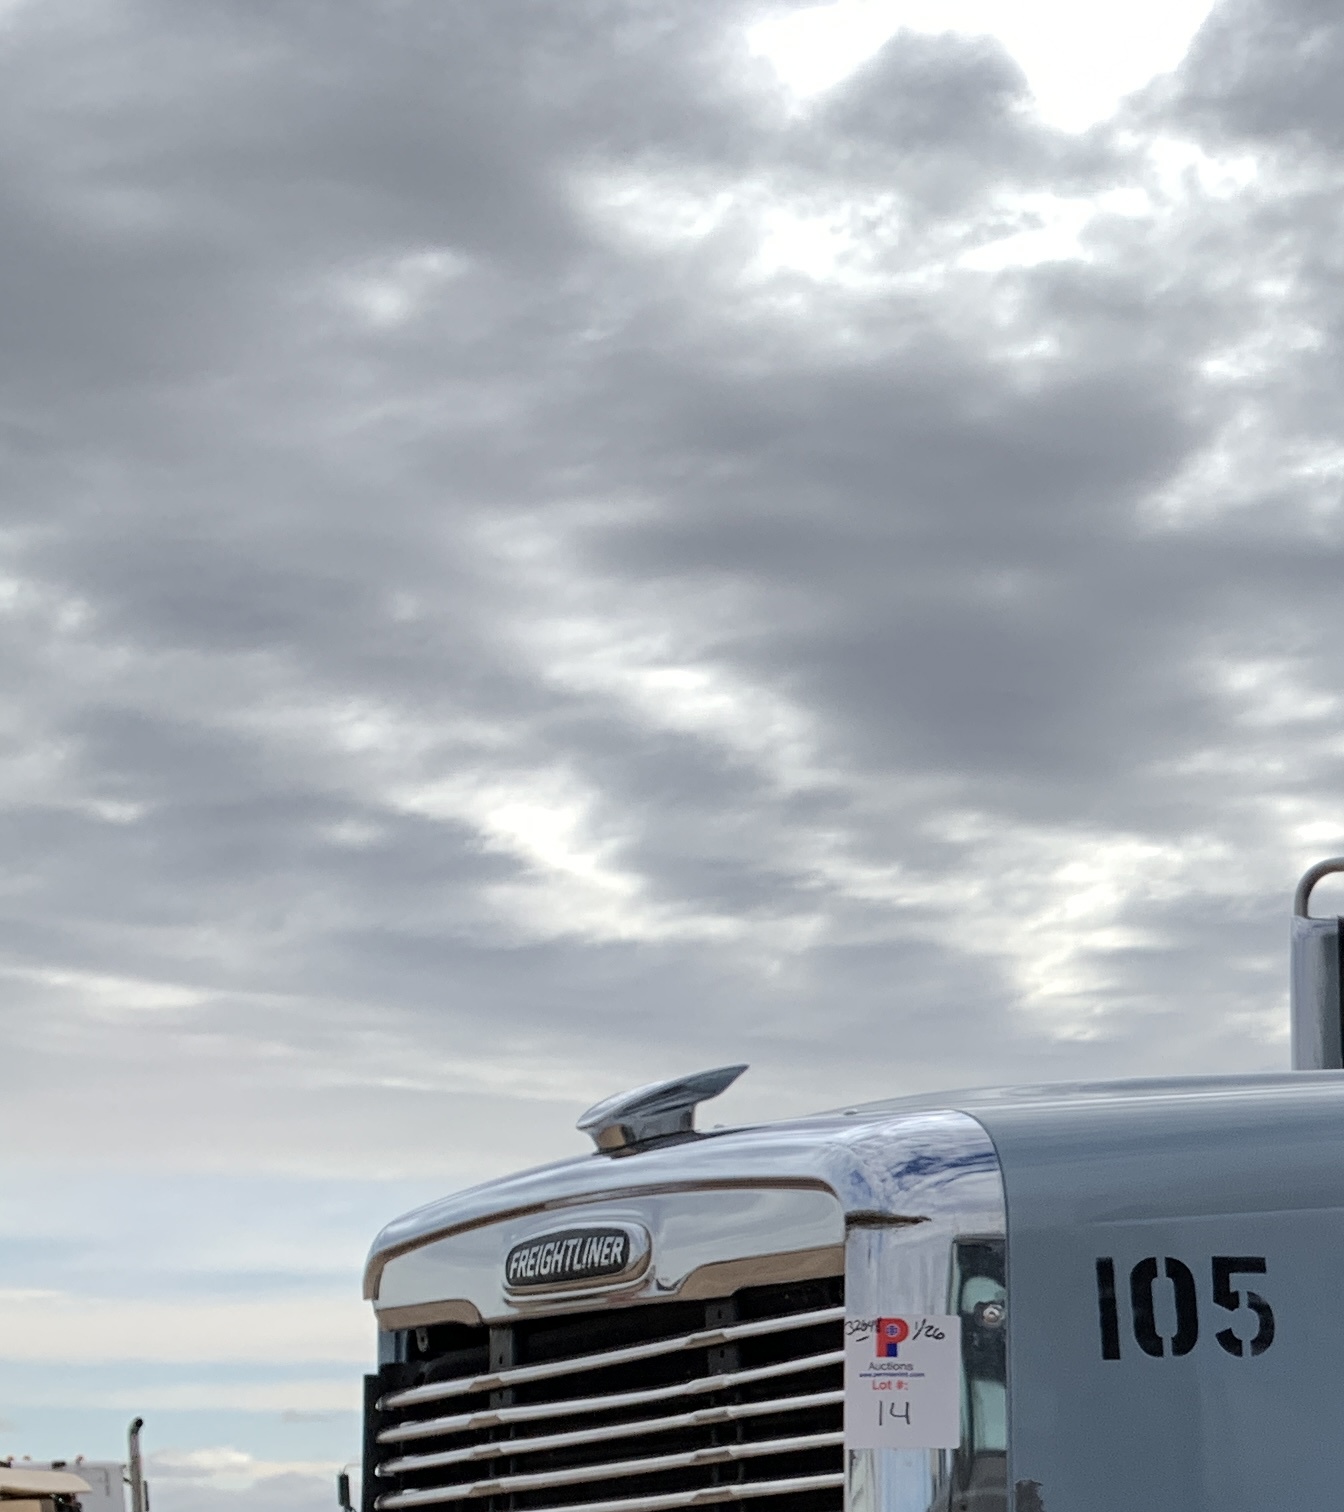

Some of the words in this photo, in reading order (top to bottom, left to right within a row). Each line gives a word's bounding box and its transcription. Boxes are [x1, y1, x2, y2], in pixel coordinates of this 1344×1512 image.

[509, 1236, 625, 1279] FREIGHTLINER
[1096, 1256, 1276, 1360] 105
[869, 1362, 914, 1371] Auctions
[872, 1380, 892, 1391] Lot
[879, 1400, 911, 1426] 14
